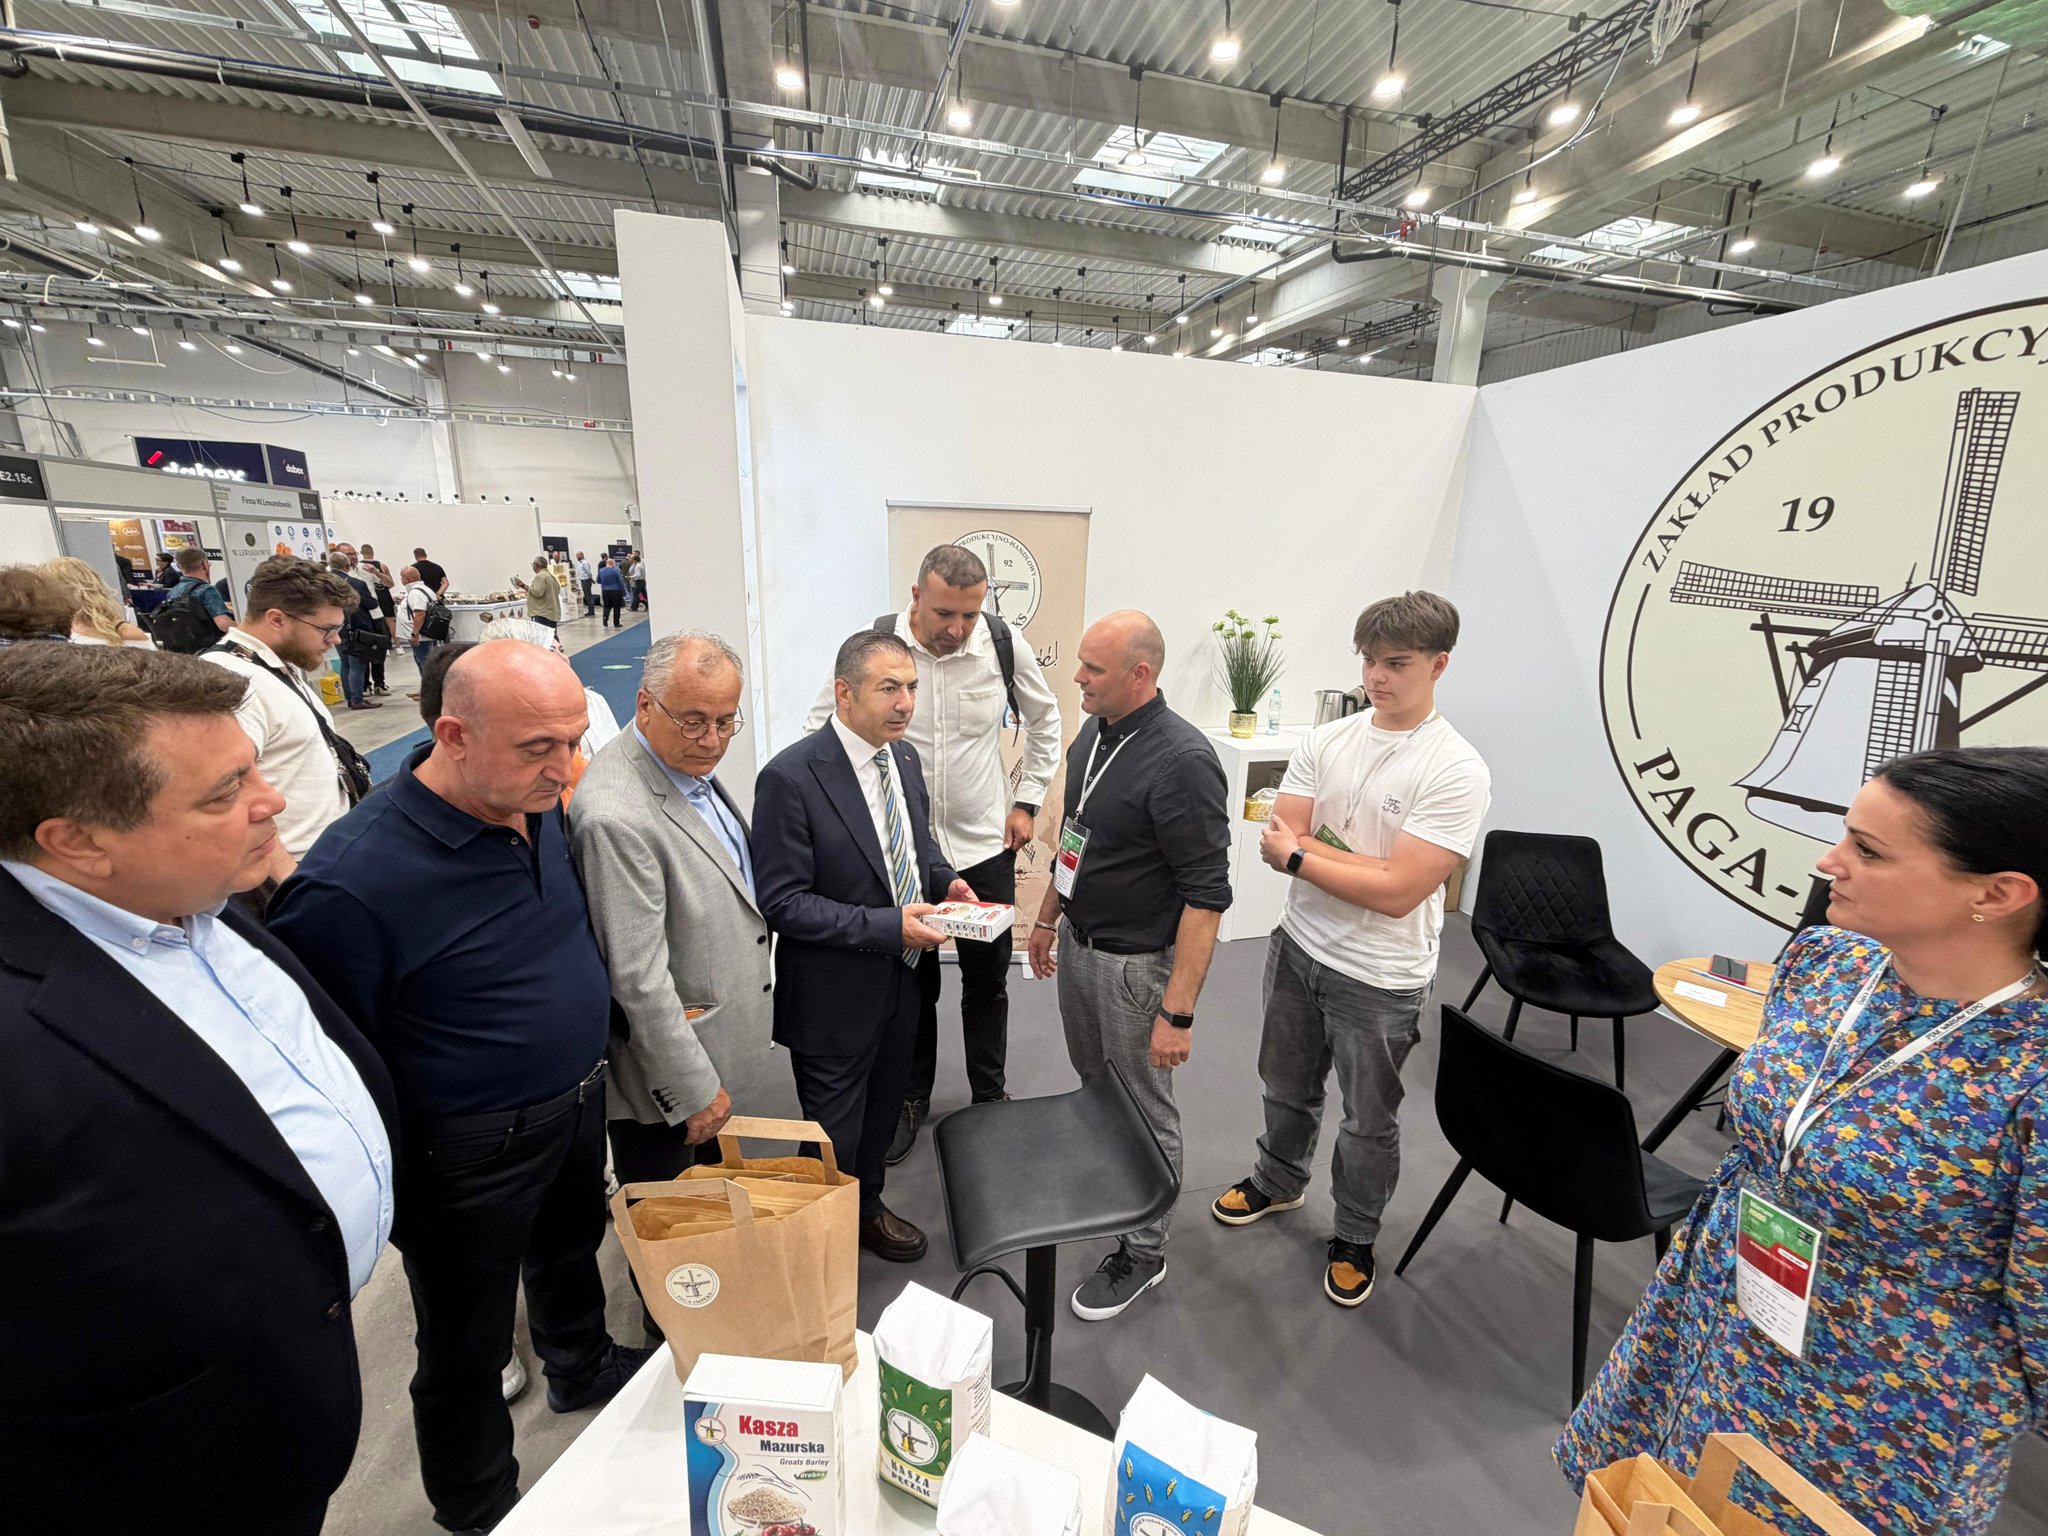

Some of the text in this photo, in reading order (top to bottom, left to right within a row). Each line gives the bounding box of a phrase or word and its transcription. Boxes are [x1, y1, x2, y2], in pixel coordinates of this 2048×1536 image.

[1641, 443, 1754, 573] ZAKŁAD
[1777, 496, 1835, 533] 19
[1003, 559, 1013, 567] 92
[1941, 1013, 1966, 1031] WARSAW
[1965, 1002, 1984, 1015] EXPO
[738, 1415, 799, 1437] Kasza
[760, 1440, 825, 1453] Mazurska
[779, 1458, 829, 1467] Groats Barley
[891, 1458, 930, 1488] KASZA
[800, 1471, 826, 1479] drobna
